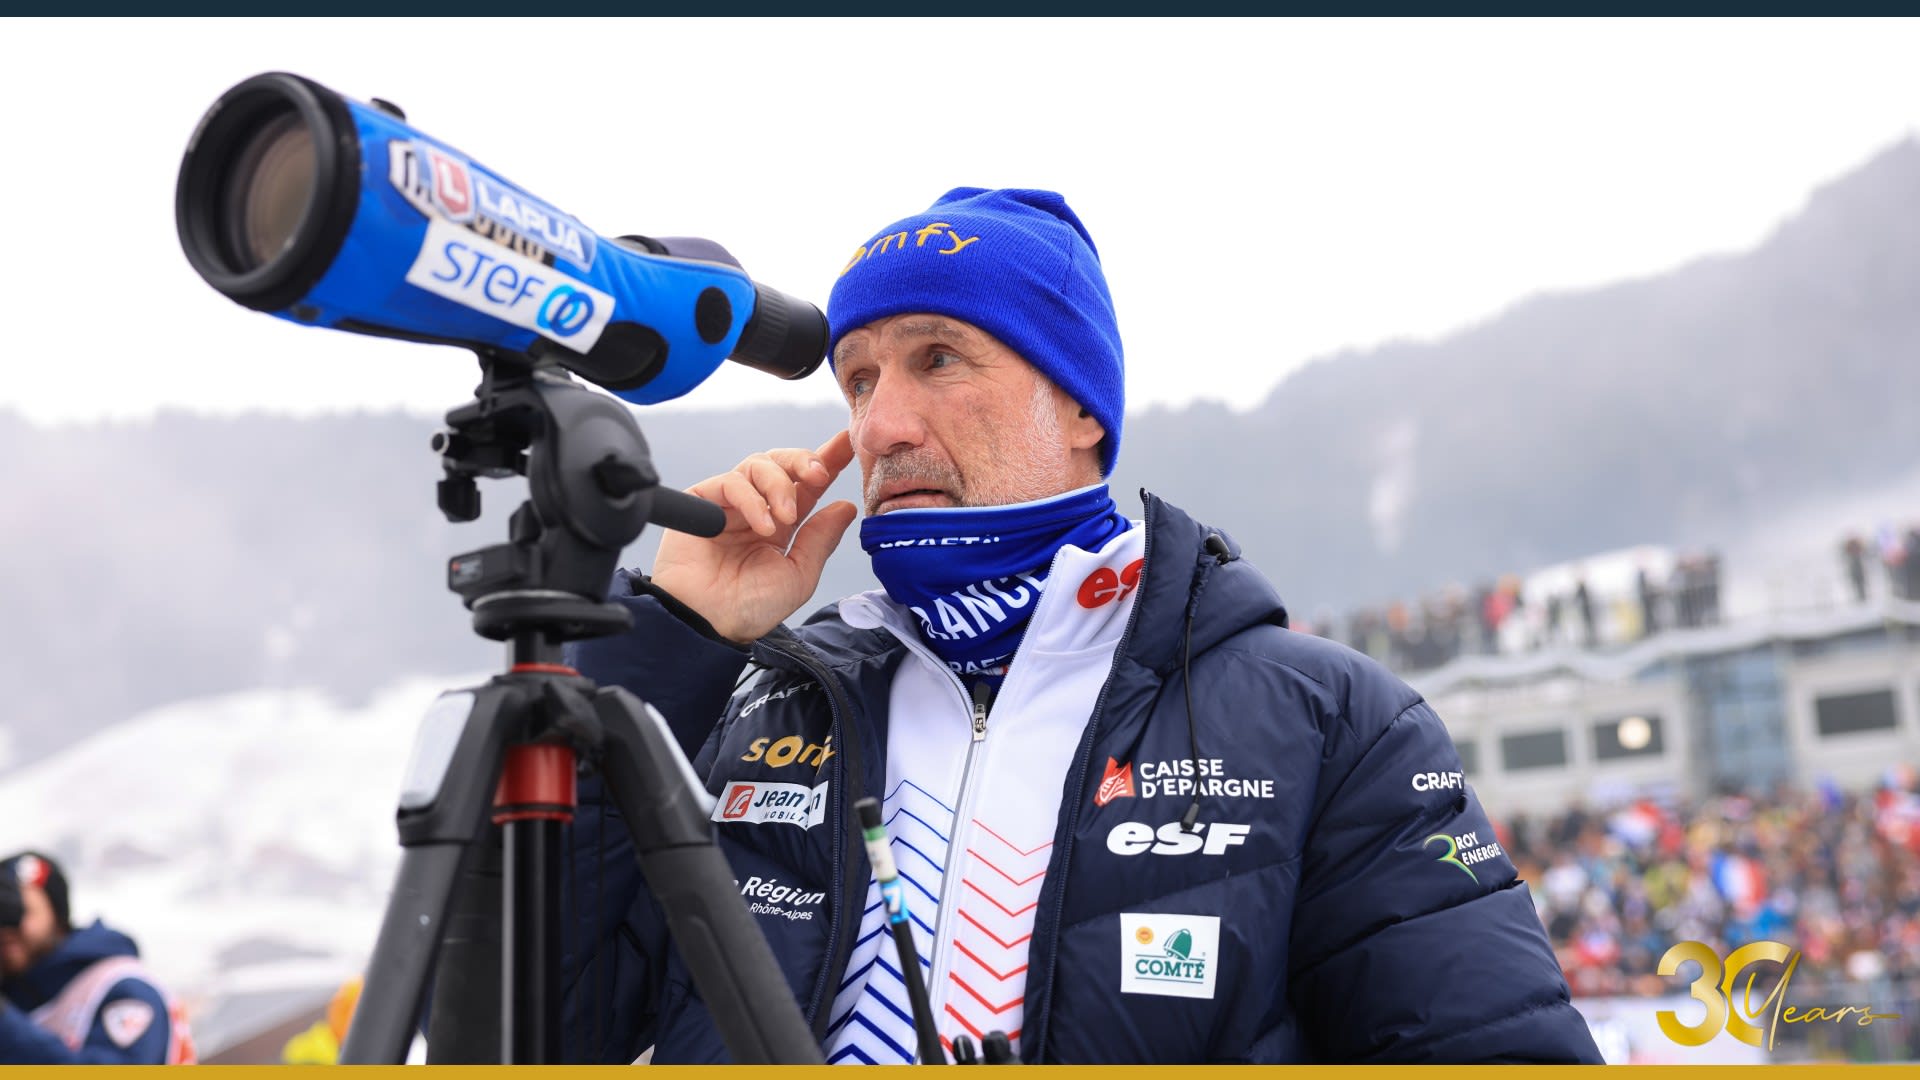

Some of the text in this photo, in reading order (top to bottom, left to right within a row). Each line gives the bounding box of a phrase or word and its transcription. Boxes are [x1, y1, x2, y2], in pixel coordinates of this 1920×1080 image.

[475, 180, 590, 264] LAPUA
[1139, 759, 1225, 781] CAISSE
[1141, 779, 1275, 799] D'EPARGNE
[1411, 771, 1463, 792] CRAFT
[1455, 832, 1479, 850] ROY
[1461, 843, 1501, 866] ENERGIE
[741, 876, 826, 906] Région
[749, 902, 814, 921] Rhône-Alpes
[1135, 958, 1205, 979] COMTÉ
